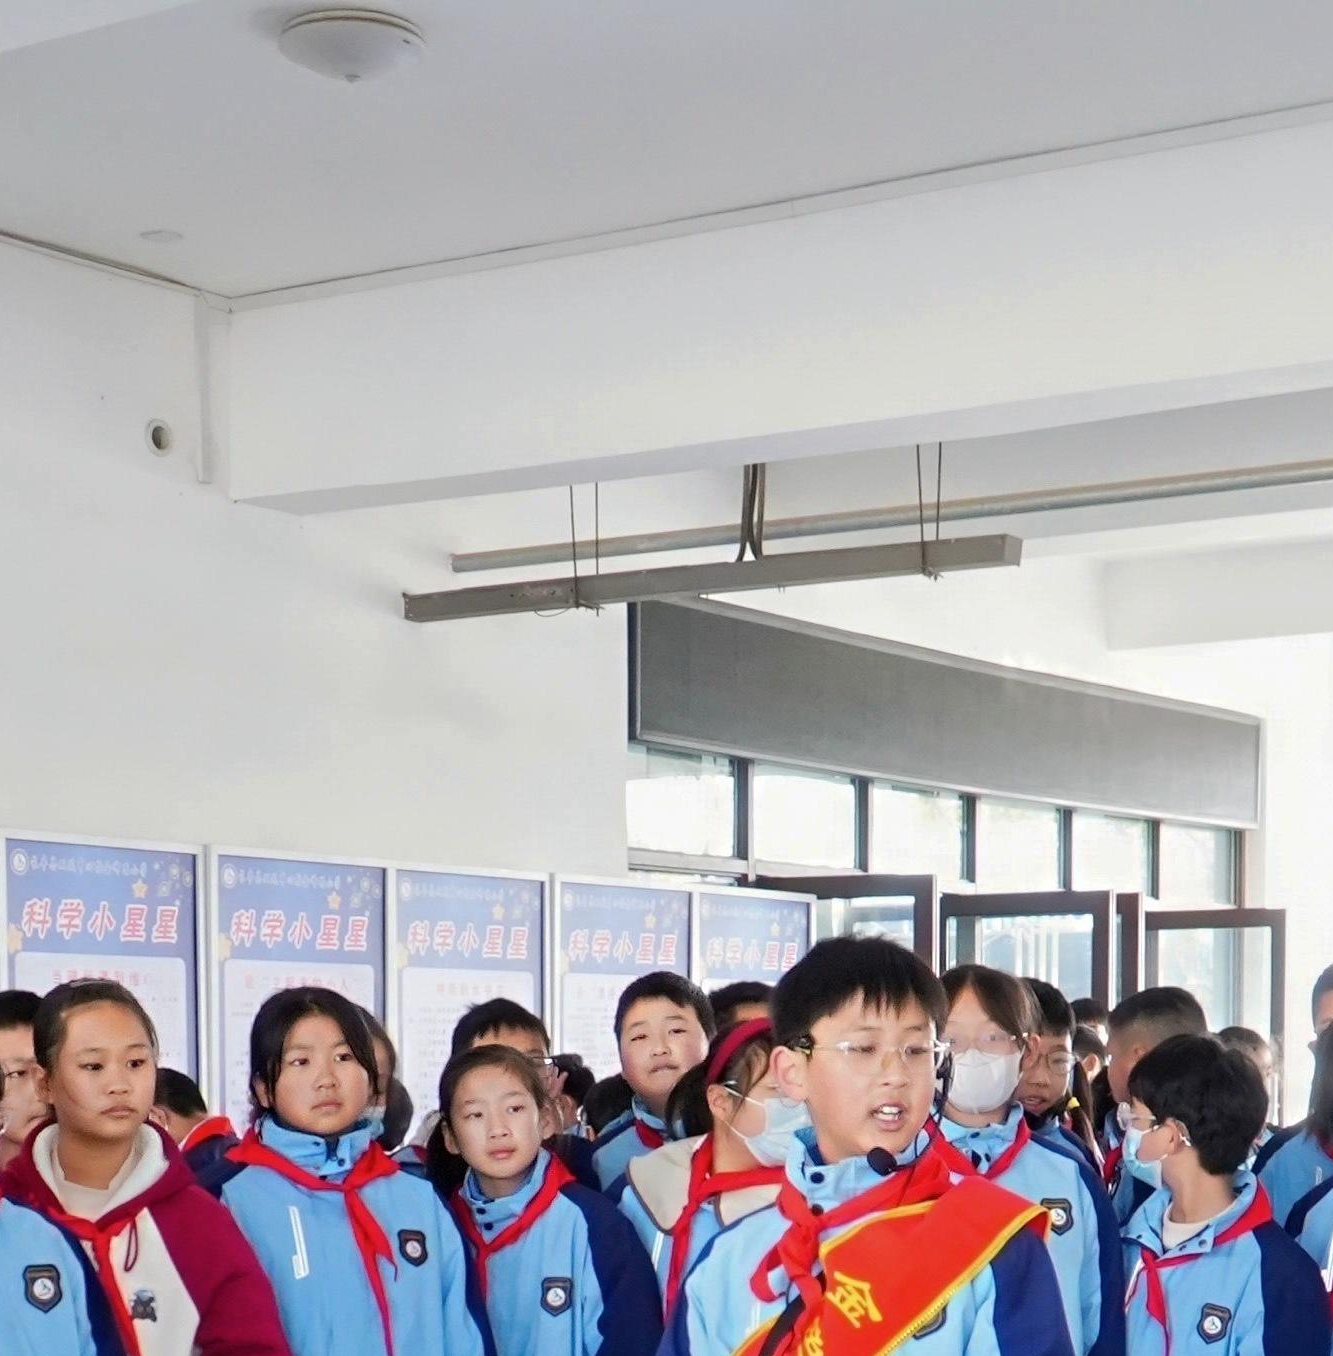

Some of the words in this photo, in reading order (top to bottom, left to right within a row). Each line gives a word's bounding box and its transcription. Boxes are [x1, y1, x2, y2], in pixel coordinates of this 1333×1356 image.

[22, 897, 178, 944] 科学小星星
[231, 909, 368, 951] 科学小星星
[408, 920, 528, 960] 科学小星星
[569, 929, 677, 965] 科学小星星
[707, 936, 798, 971] 科学小星星
